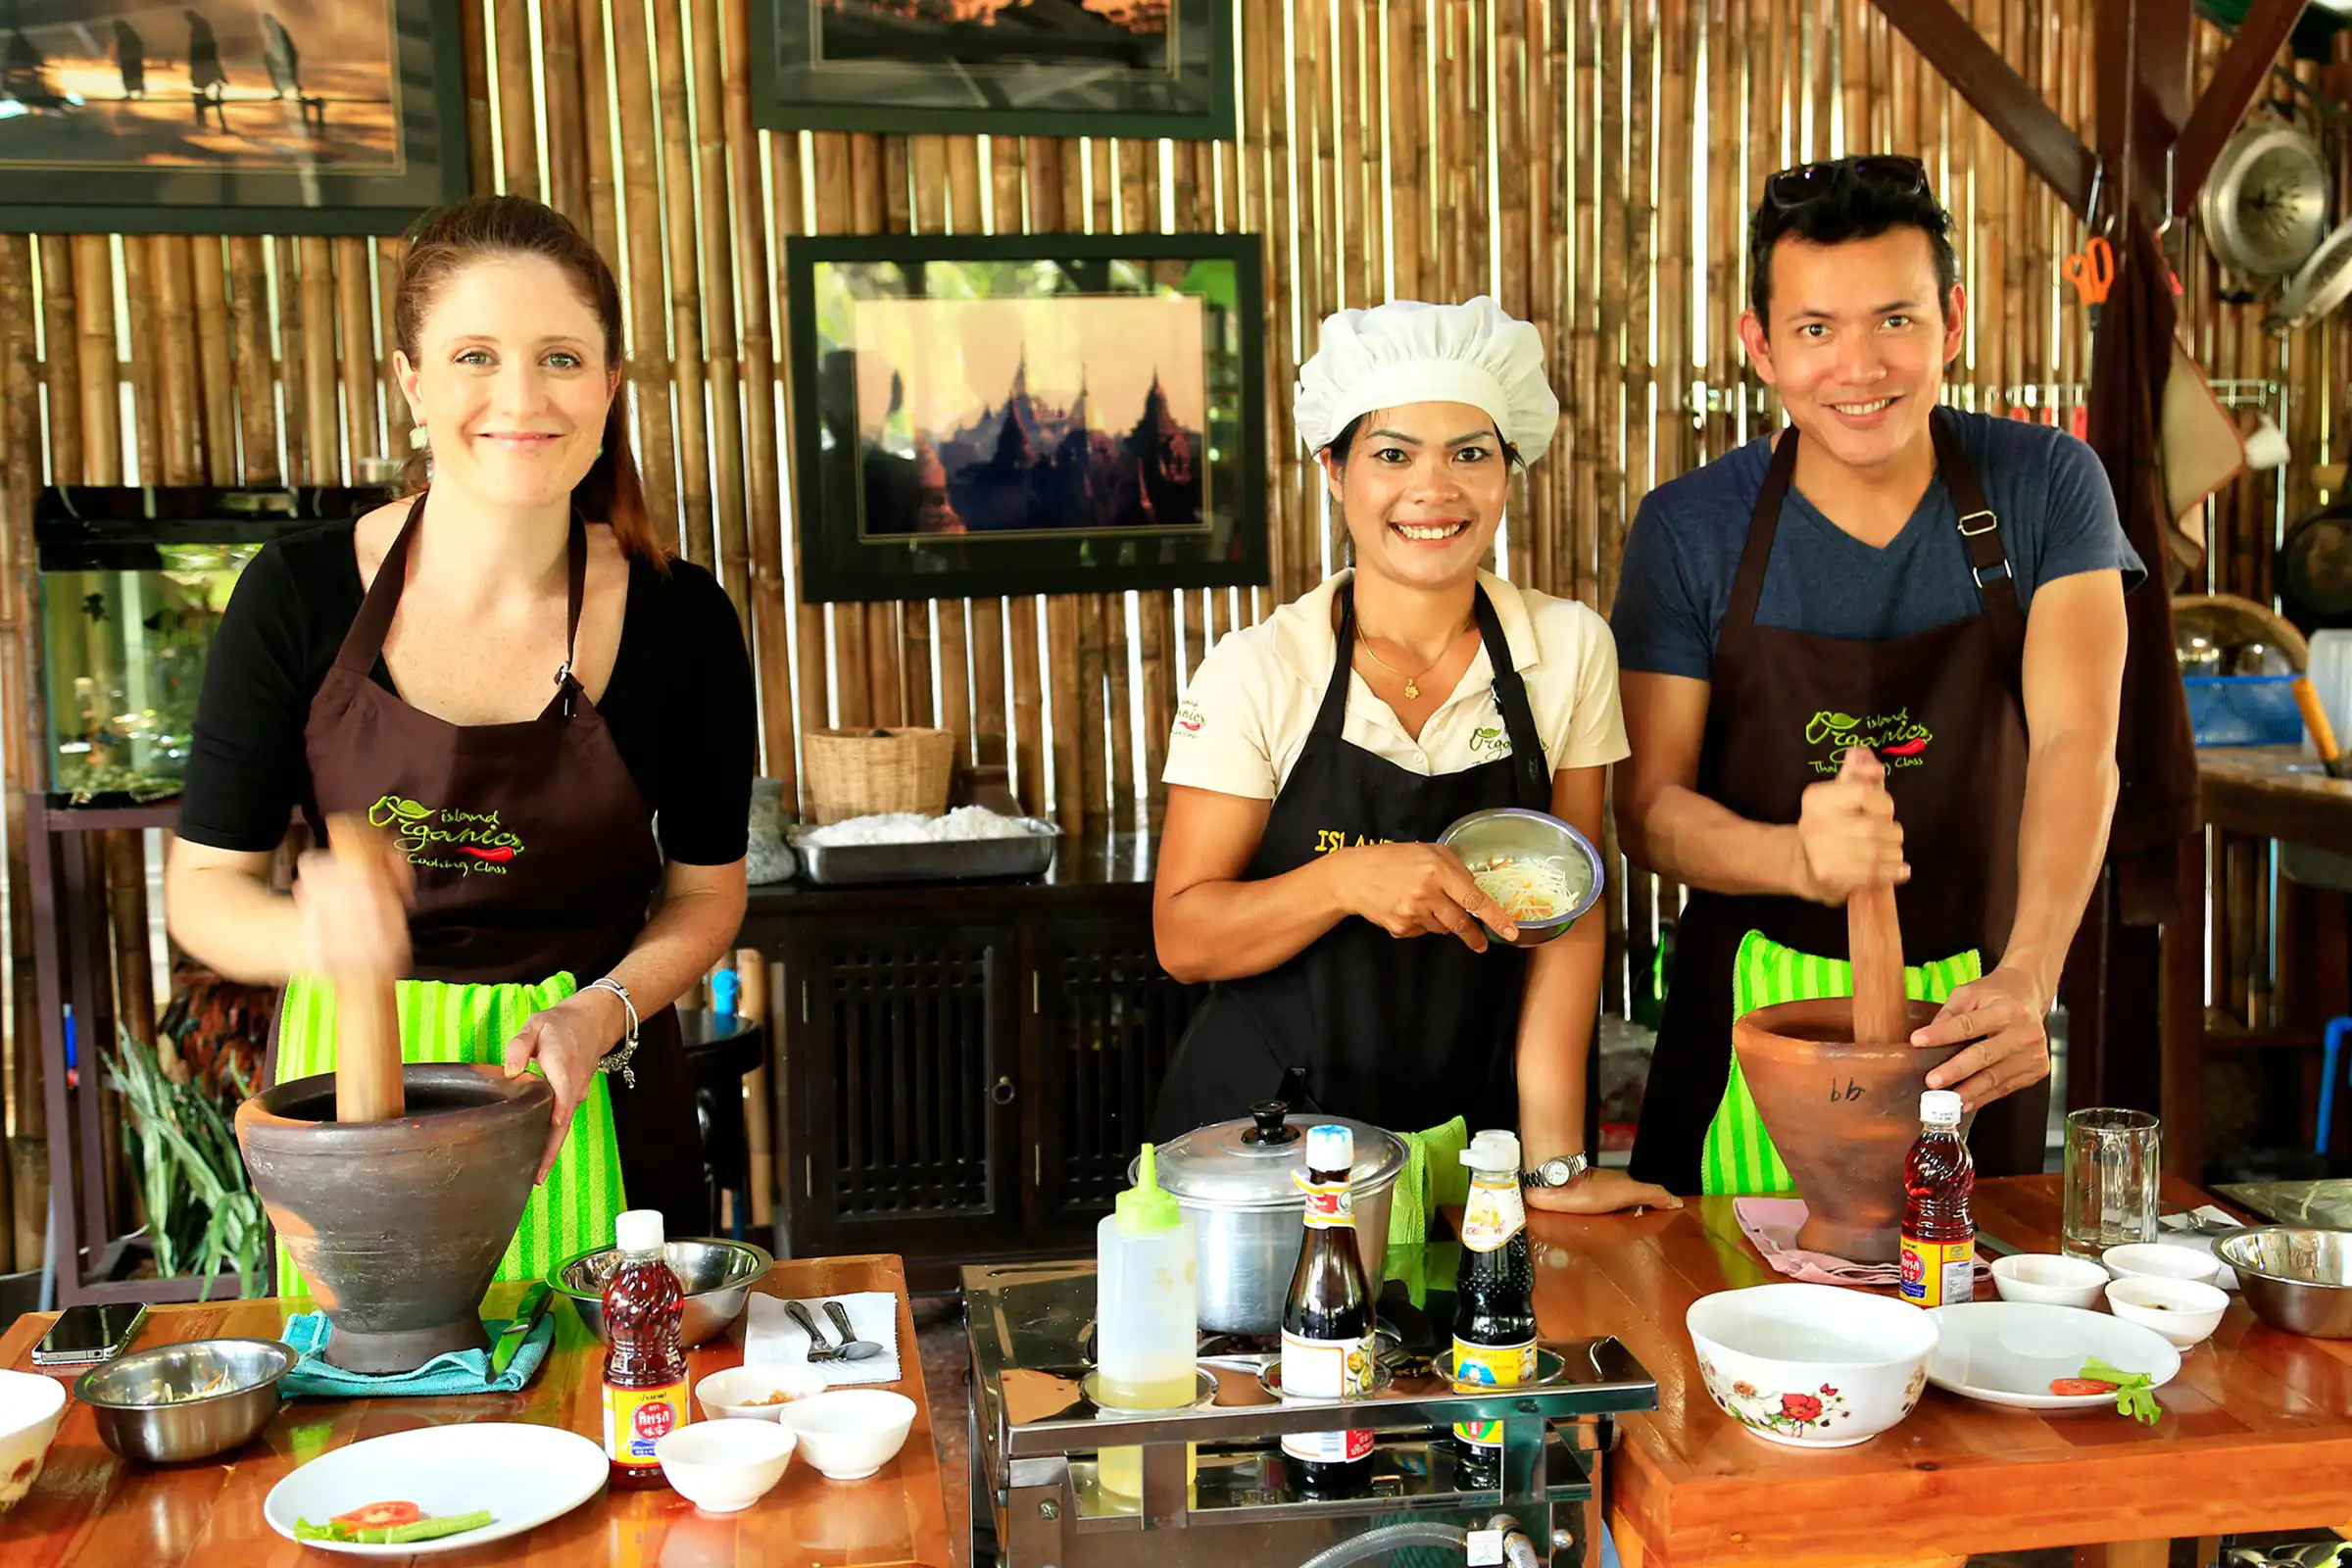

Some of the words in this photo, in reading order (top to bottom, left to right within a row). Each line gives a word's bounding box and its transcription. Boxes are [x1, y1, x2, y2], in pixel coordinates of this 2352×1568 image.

[1867, 707, 1909, 729] island
[1805, 710, 1933, 763] Organics
[1894, 757, 1924, 768] Class
[368, 796, 525, 852] Organics
[441, 808, 500, 825] island
[407, 854, 468, 877] Cooking
[473, 860, 508, 875] Class
